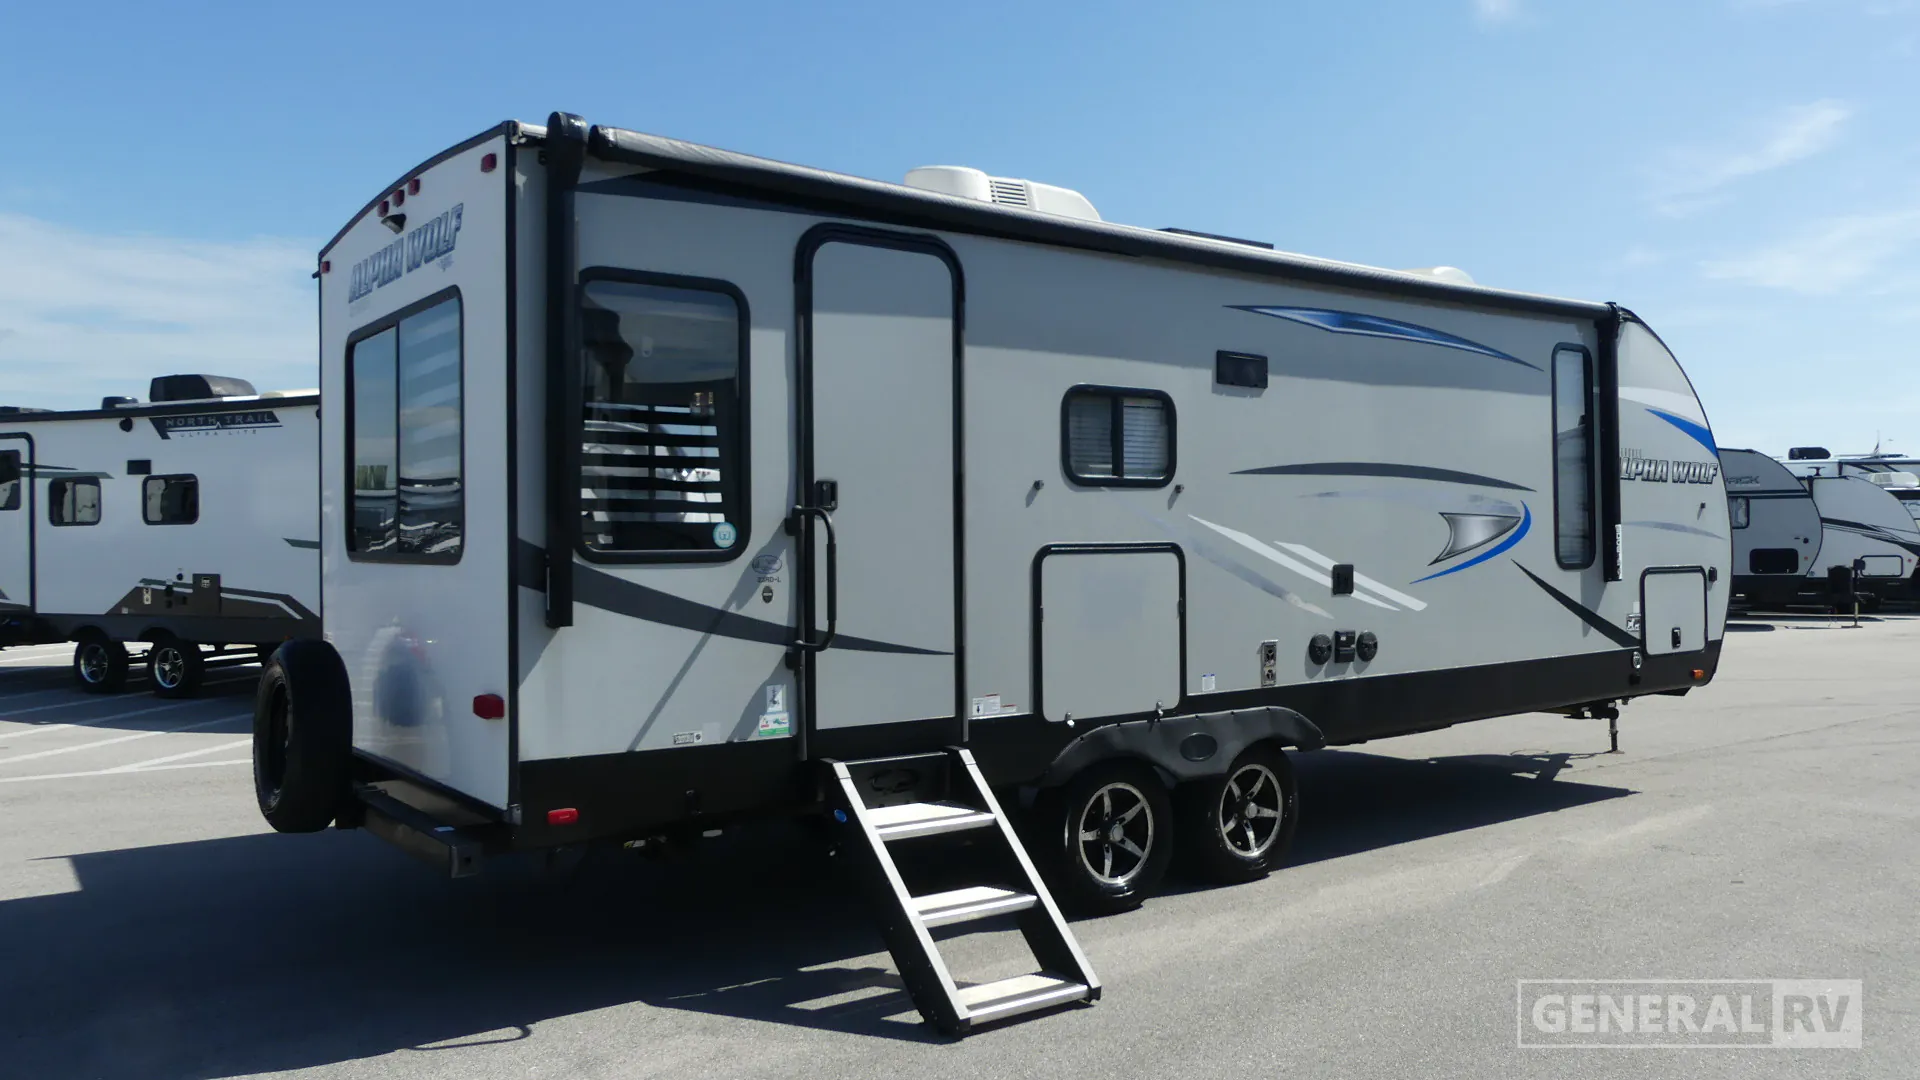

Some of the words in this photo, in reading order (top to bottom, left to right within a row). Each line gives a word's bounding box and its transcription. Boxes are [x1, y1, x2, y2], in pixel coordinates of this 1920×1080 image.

[348, 237, 404, 304] ALPHA
[406, 203, 463, 273] WOLF
[166, 416, 216, 427] NORTH
[224, 413, 274, 425] TRAIL
[1620, 457, 1668, 482] LPHA
[1672, 461, 1718, 484] WOLF
